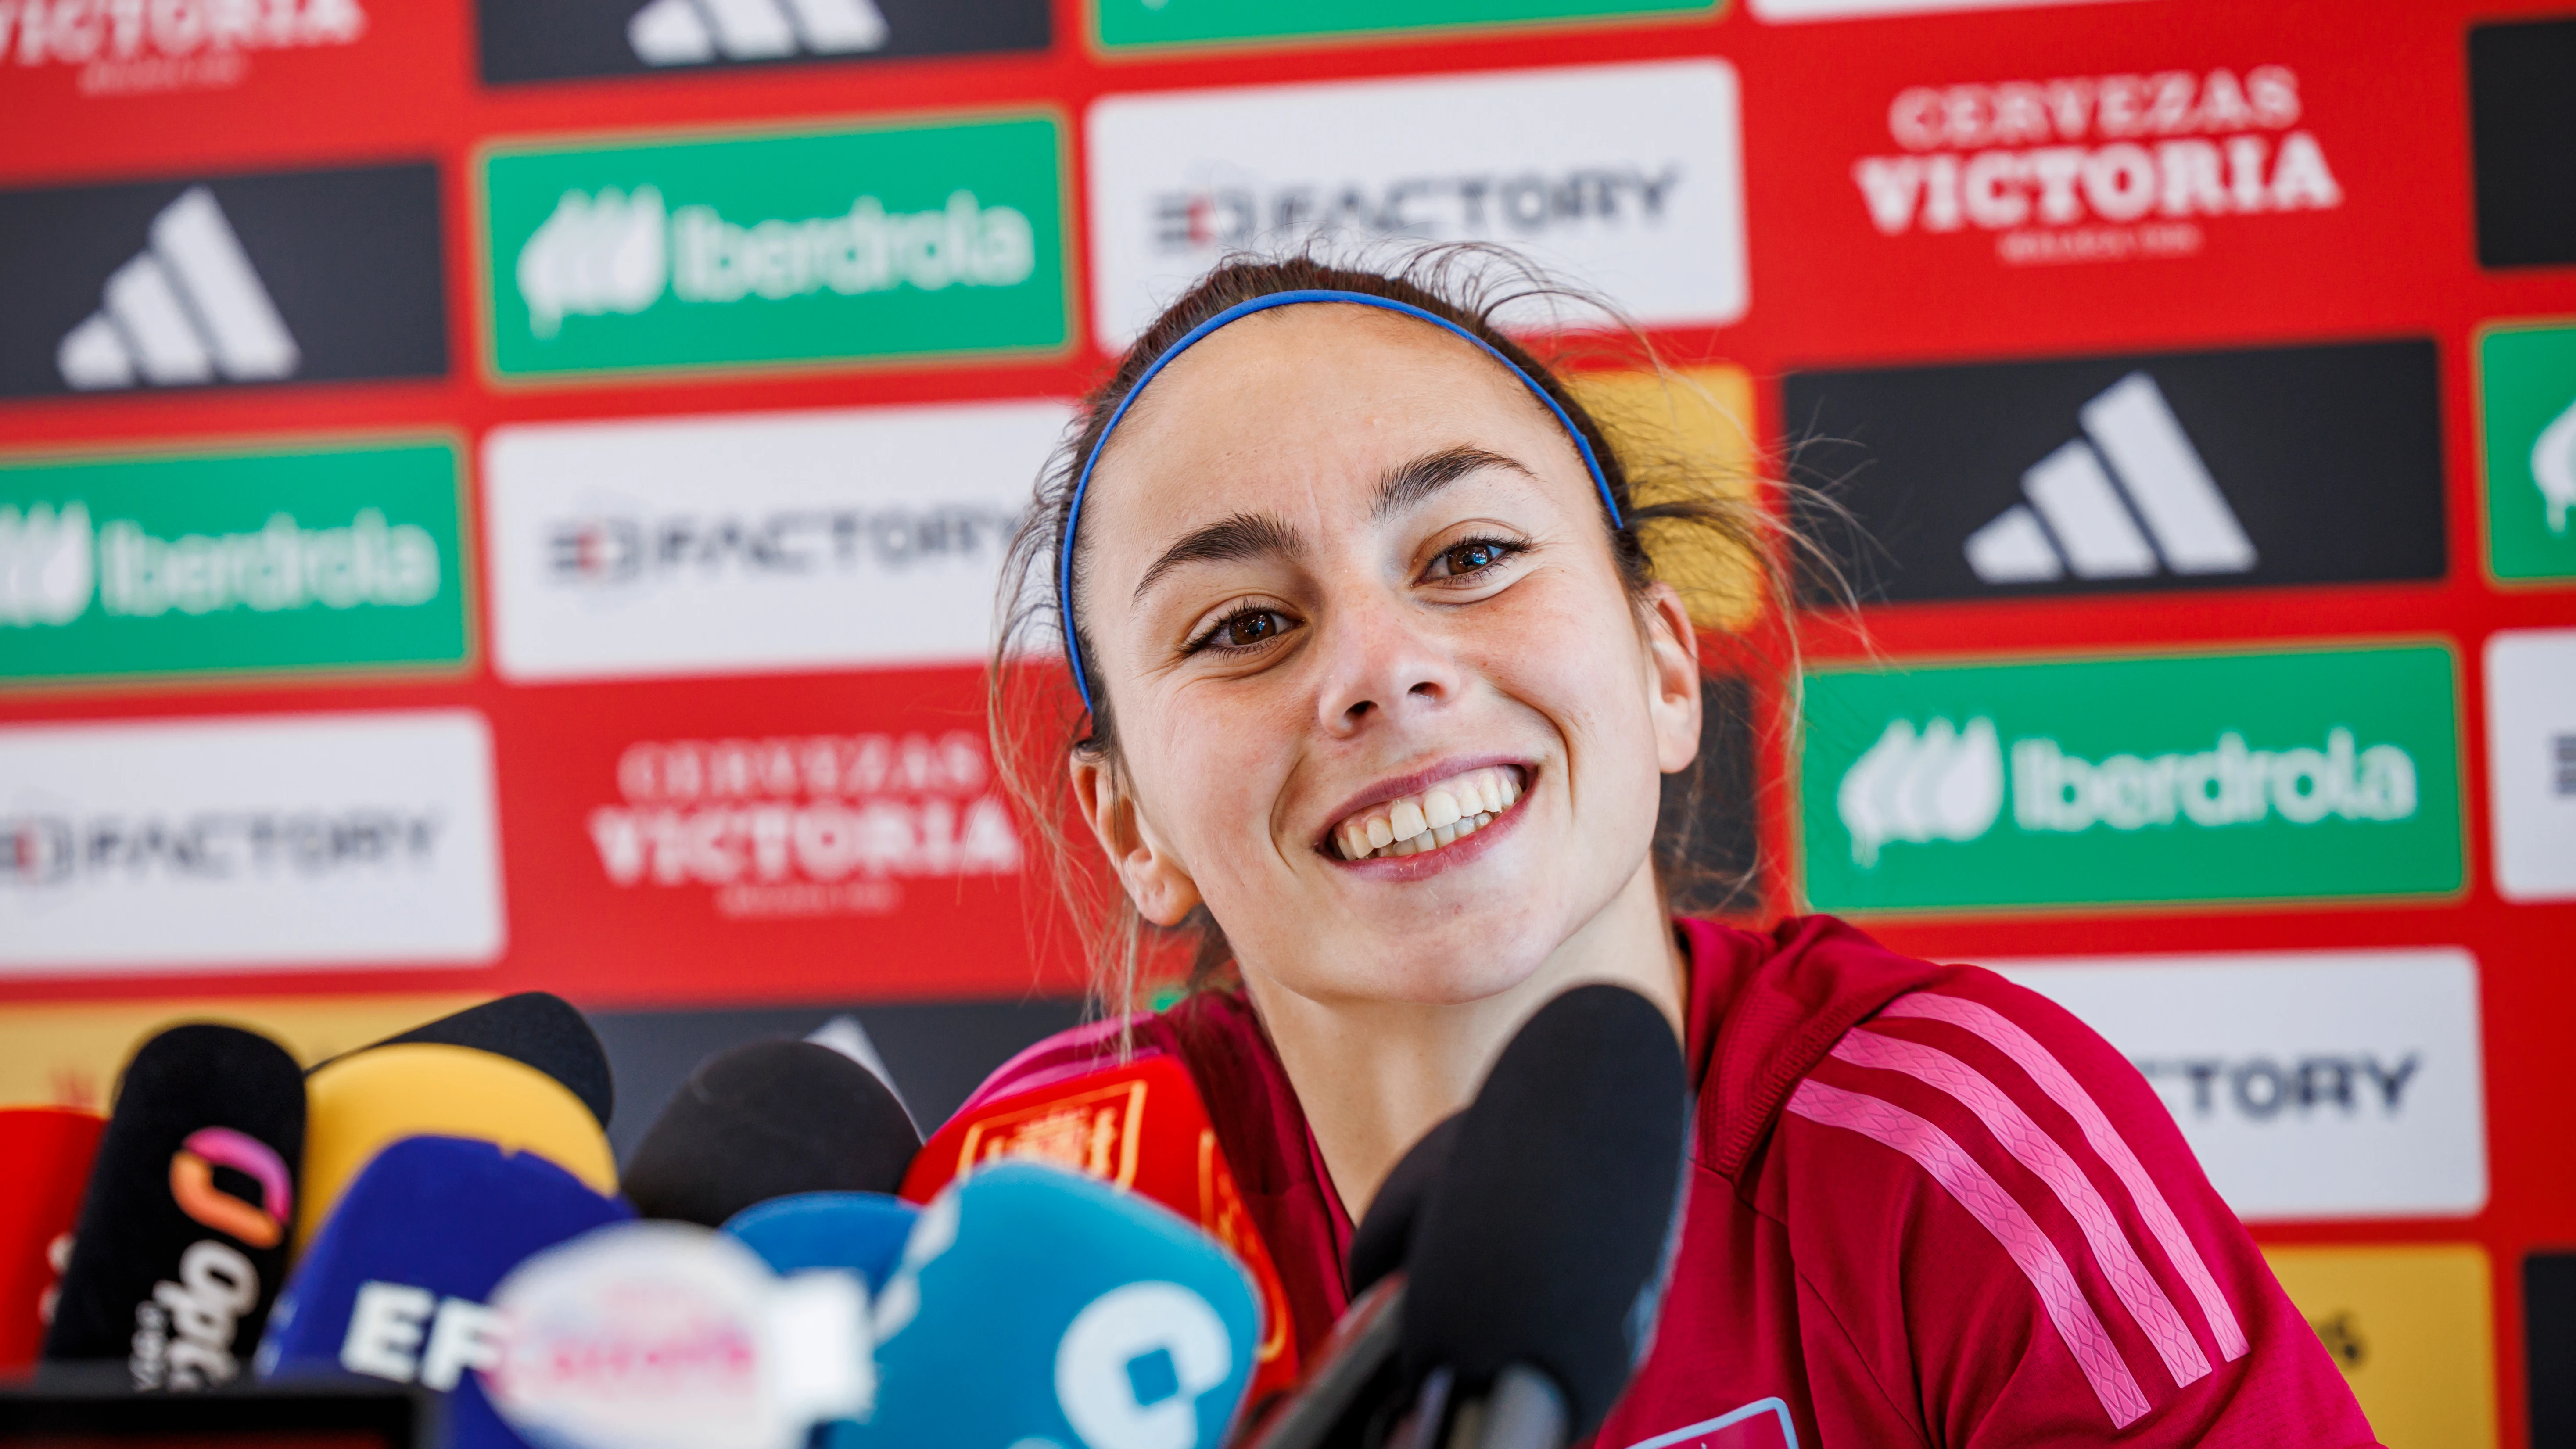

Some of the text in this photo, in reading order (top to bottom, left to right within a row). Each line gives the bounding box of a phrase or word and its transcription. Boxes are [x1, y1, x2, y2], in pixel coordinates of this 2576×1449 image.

[0, 0, 366, 66] ICTORIA
[1889, 66, 2300, 148] CERVEZAS
[1270, 159, 1683, 244] FACTORY
[1854, 133, 2340, 233] VICTORIA
[672, 190, 1035, 303] Iberdrola
[101, 508, 440, 614] Iberdrola
[2011, 726, 2417, 832] Iberdrola
[587, 795, 1020, 886] VICTORIA
[2135, 1051, 2420, 1123] TORY
[340, 1279, 500, 1392] EF
